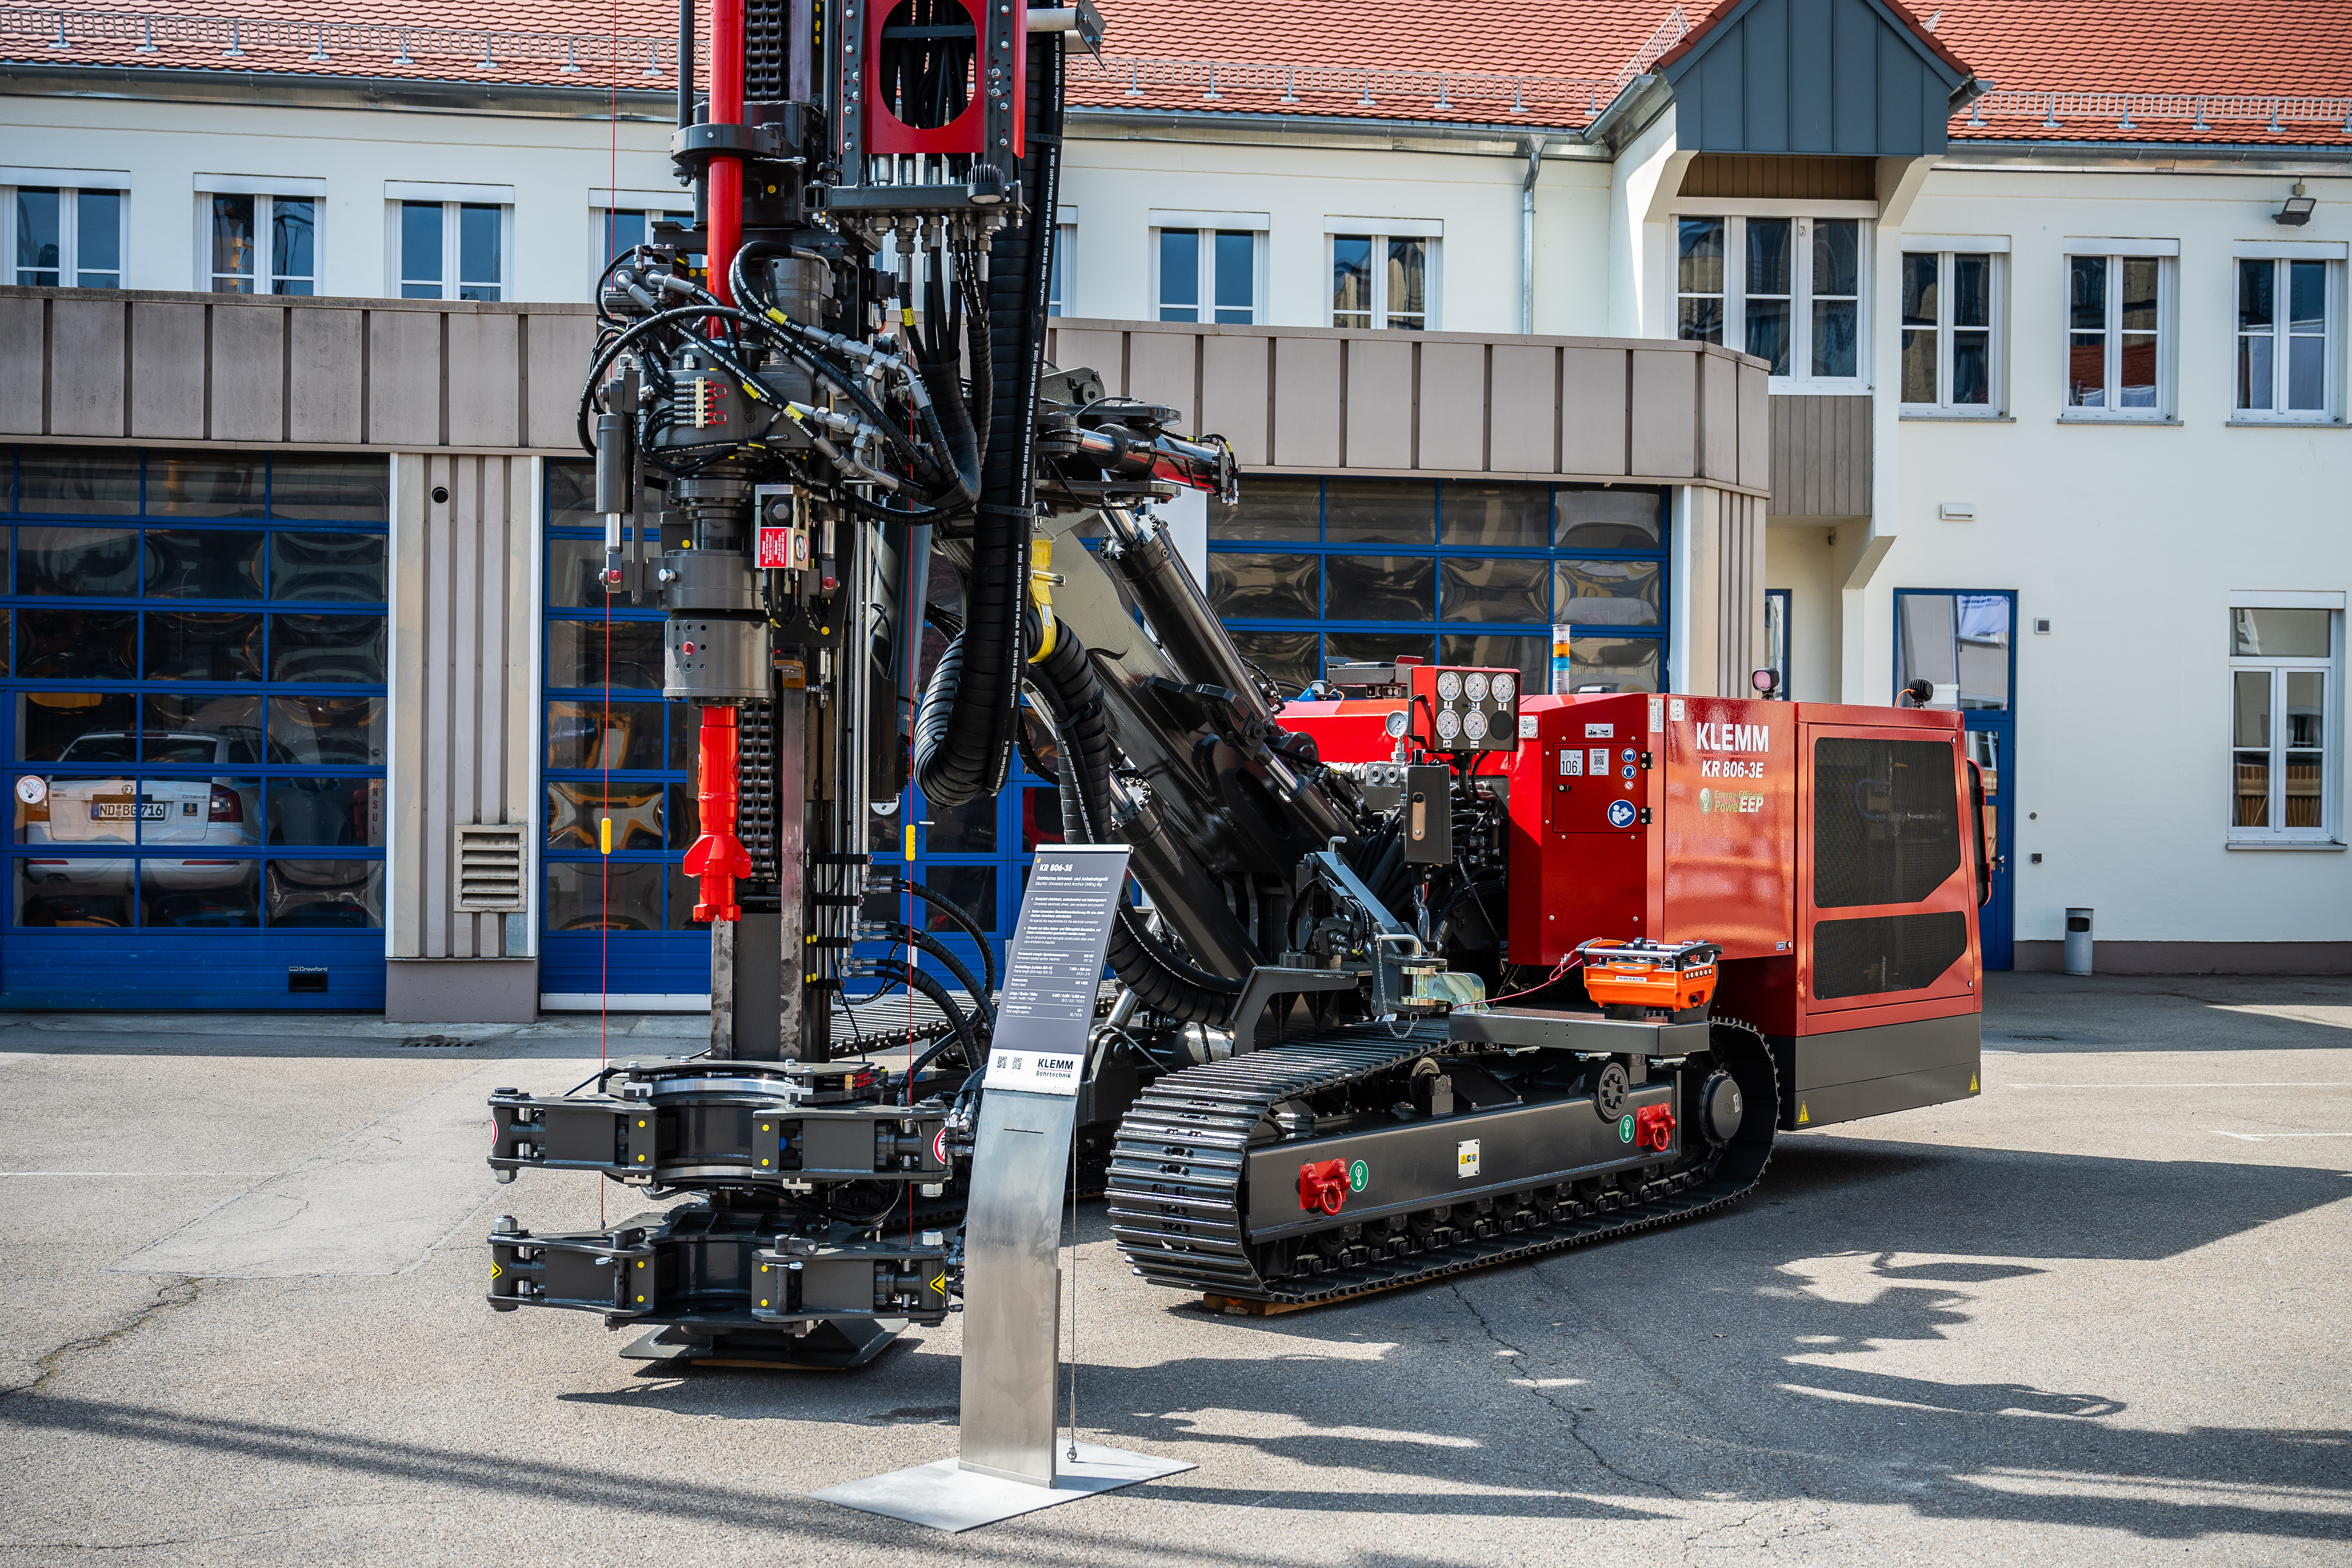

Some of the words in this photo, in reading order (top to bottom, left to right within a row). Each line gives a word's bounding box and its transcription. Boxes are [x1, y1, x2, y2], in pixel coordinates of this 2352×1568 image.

[779, 331, 793, 343] MSHA
[1027, 416, 1031, 425] WP
[1015, 620, 1020, 628] WP
[1696, 722, 1769, 752] KLEMM
[1561, 761, 1577, 774] 106
[1701, 760, 1720, 777] KR
[1722, 761, 1764, 778] 806-3E
[1714, 790, 1764, 801] Energy-Efficient
[100, 803, 114, 816] ND
[123, 803, 136, 816] BG
[141, 803, 163, 816] 716
[1714, 800, 1742, 812] Power
[1739, 796, 1764, 813] EEP
[1038, 1059, 1073, 1070] KLEMM
